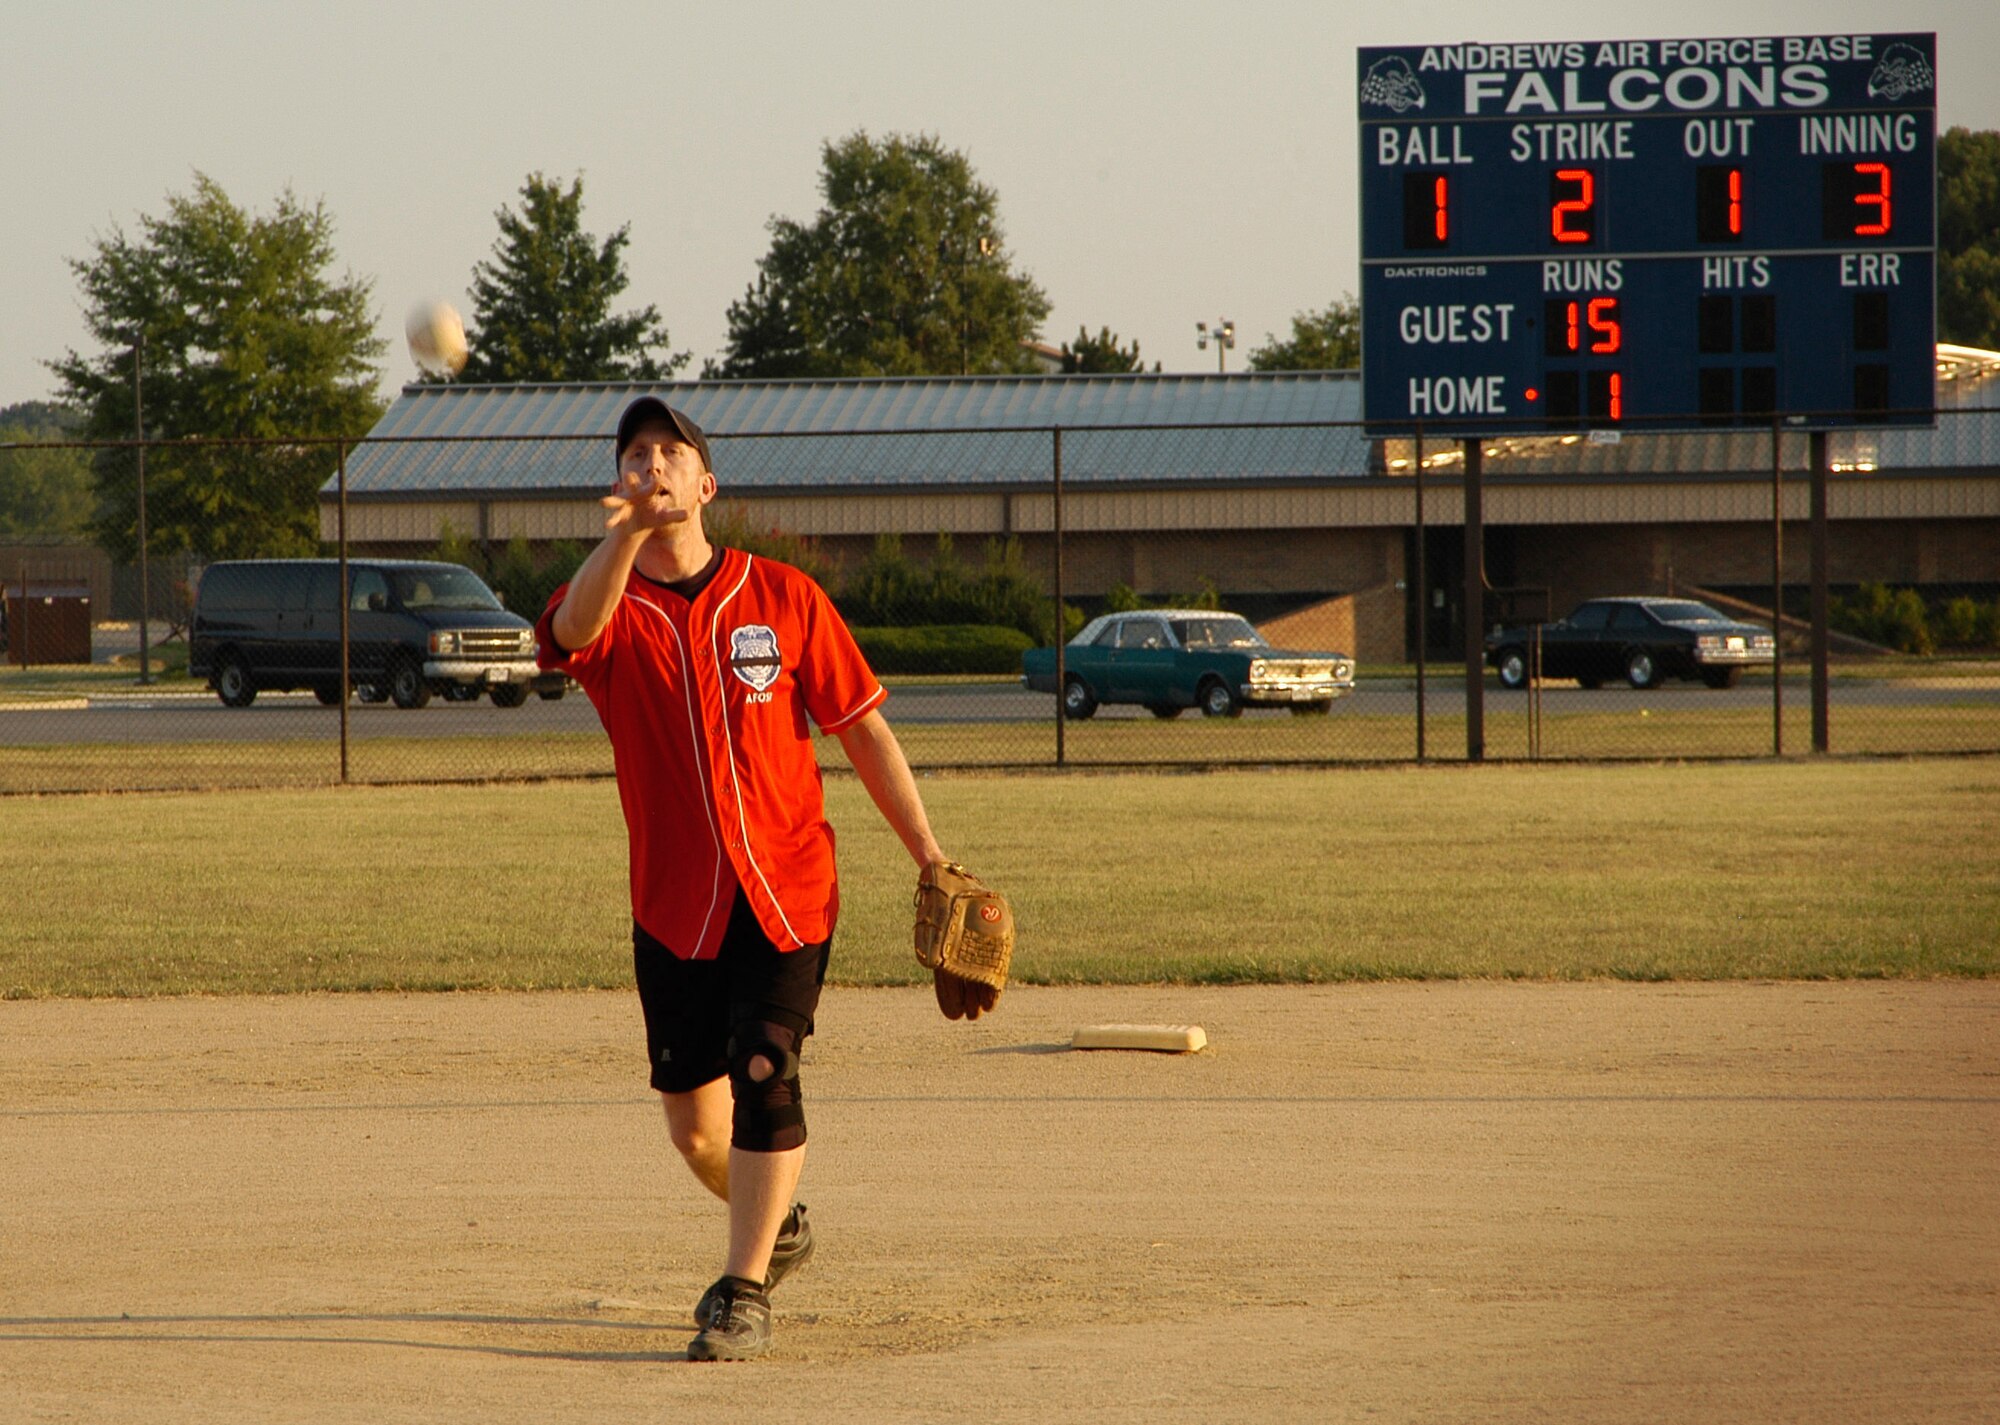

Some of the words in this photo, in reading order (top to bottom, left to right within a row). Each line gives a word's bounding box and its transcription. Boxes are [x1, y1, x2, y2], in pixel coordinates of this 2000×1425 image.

[1419, 44, 1586, 71] ANDREWS
[1595, 42, 1650, 66] AIR
[1660, 39, 1773, 65] FORCE
[1783, 36, 1872, 61] BASE
[1464, 64, 1829, 114] FALCONS
[1378, 126, 1473, 165] BALL
[1510, 121, 1634, 162] STRIKE
[1684, 118, 1754, 157] OUT
[1800, 113, 1917, 154] INNING
[1435, 176, 1446, 241] 1
[1552, 170, 1594, 241] 2
[1728, 170, 1741, 234] 1
[1854, 162, 1892, 236] 3
[1384, 265, 1487, 278] DAKTRONICS
[1544, 260, 1623, 292] RUNS
[1703, 256, 1770, 288] HITS
[1840, 253, 1900, 286] ERR
[1400, 304, 1514, 343] GUEST
[1568, 298, 1620, 353] 15
[1409, 376, 1506, 414] HOME
[1610, 373, 1621, 420] 1
